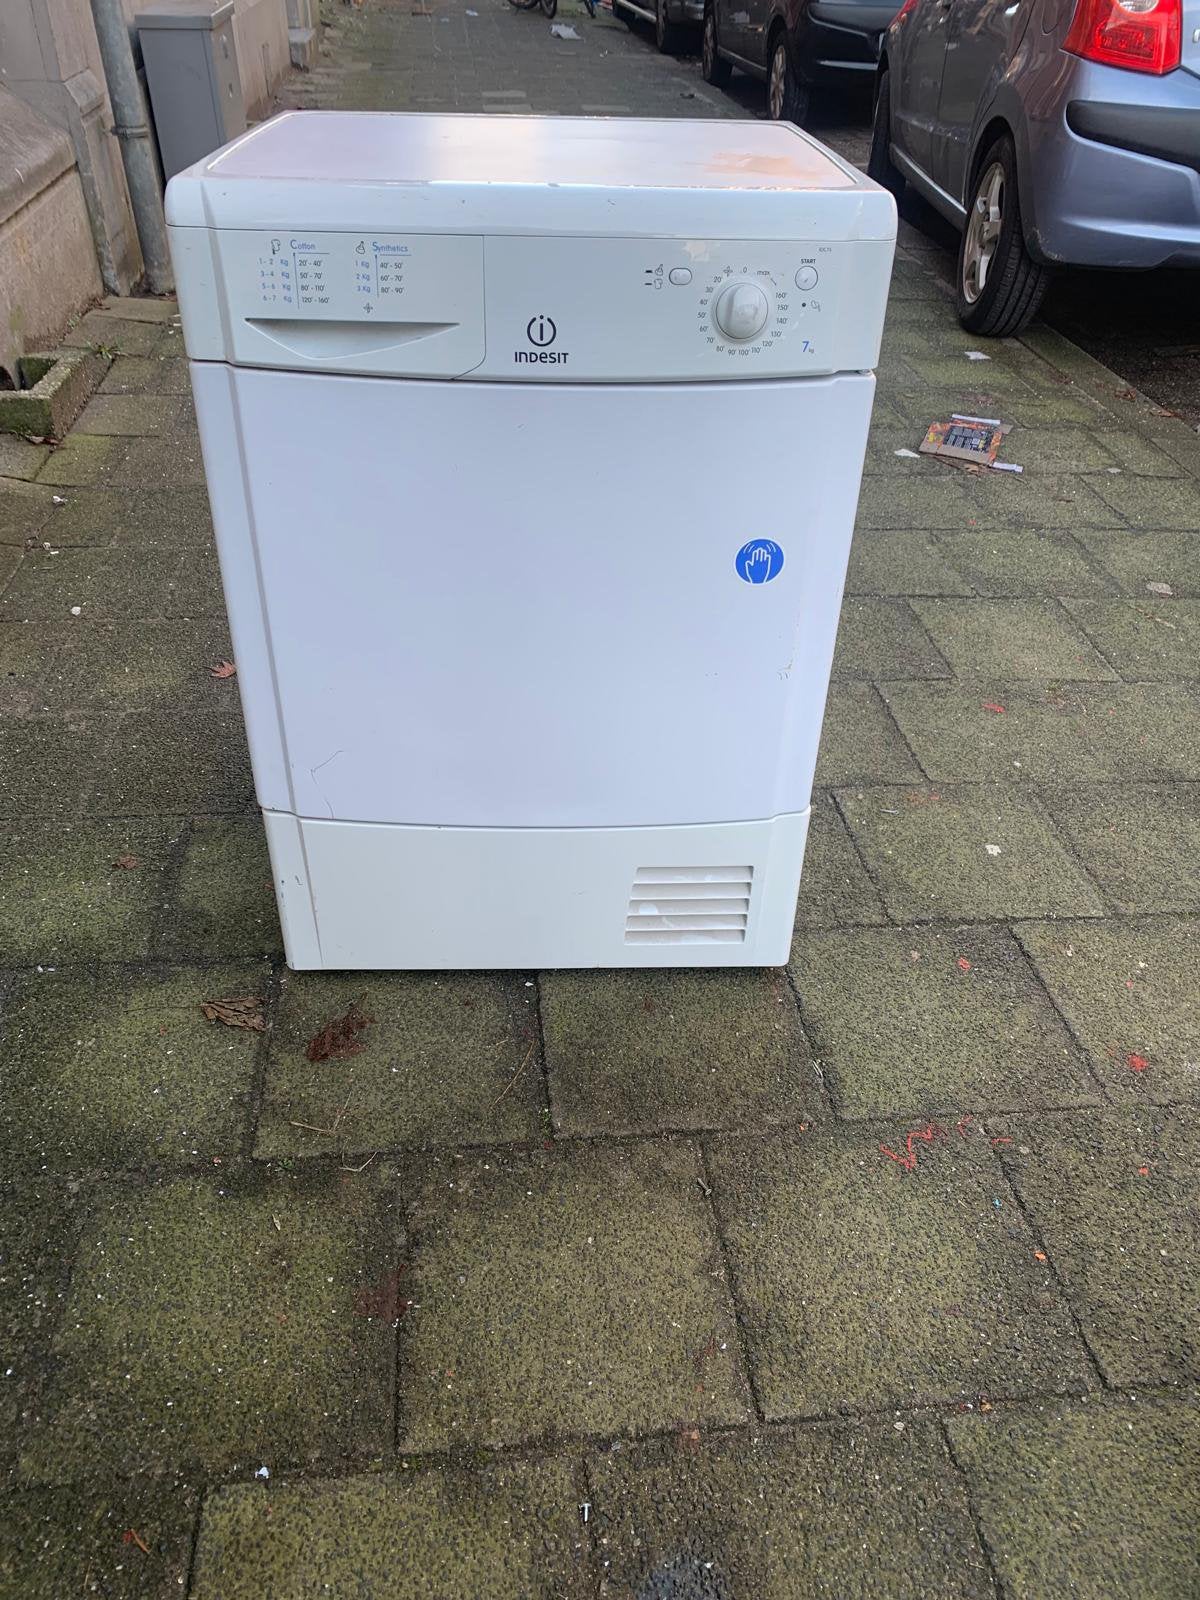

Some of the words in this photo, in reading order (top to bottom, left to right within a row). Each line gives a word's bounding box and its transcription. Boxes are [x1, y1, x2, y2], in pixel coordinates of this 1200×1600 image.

[290, 239, 316, 250] Cotton
[372, 241, 409, 253] Synthetics
[802, 340, 810, 353] 7
